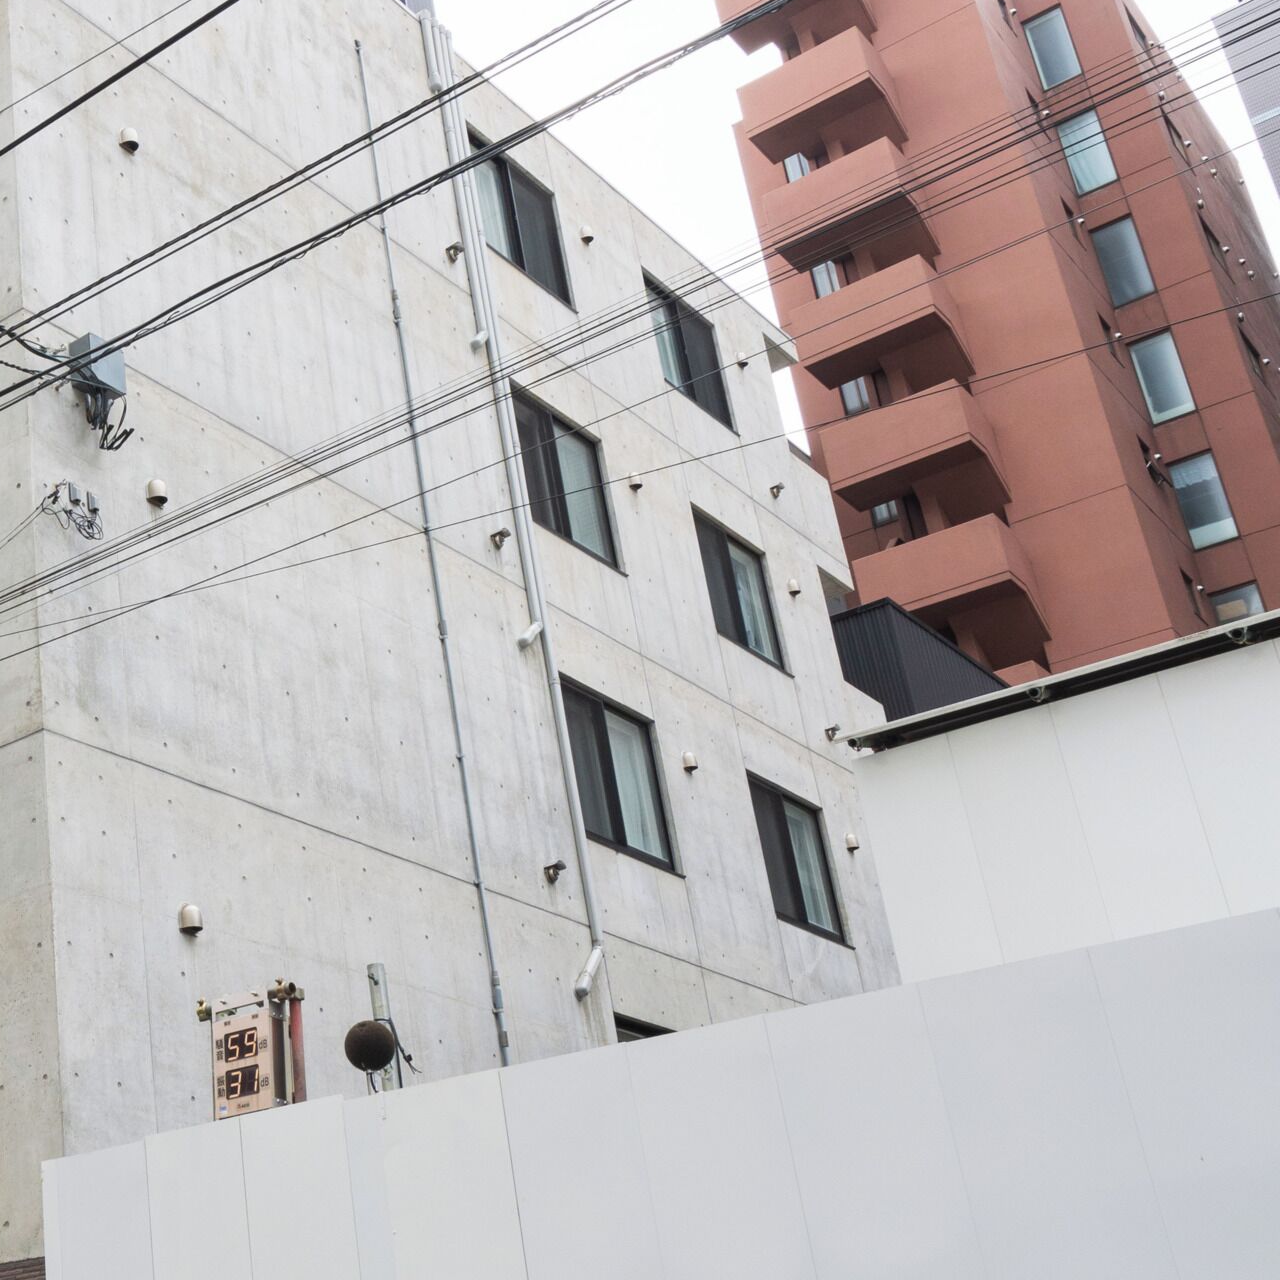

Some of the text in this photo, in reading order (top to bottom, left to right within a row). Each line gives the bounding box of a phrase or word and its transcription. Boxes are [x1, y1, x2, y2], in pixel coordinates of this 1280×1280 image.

[227, 1030, 257, 1061] 59
[259, 1039, 268, 1050] dB
[229, 1068, 259, 1099] 31
[260, 1077, 269, 1087] dB
